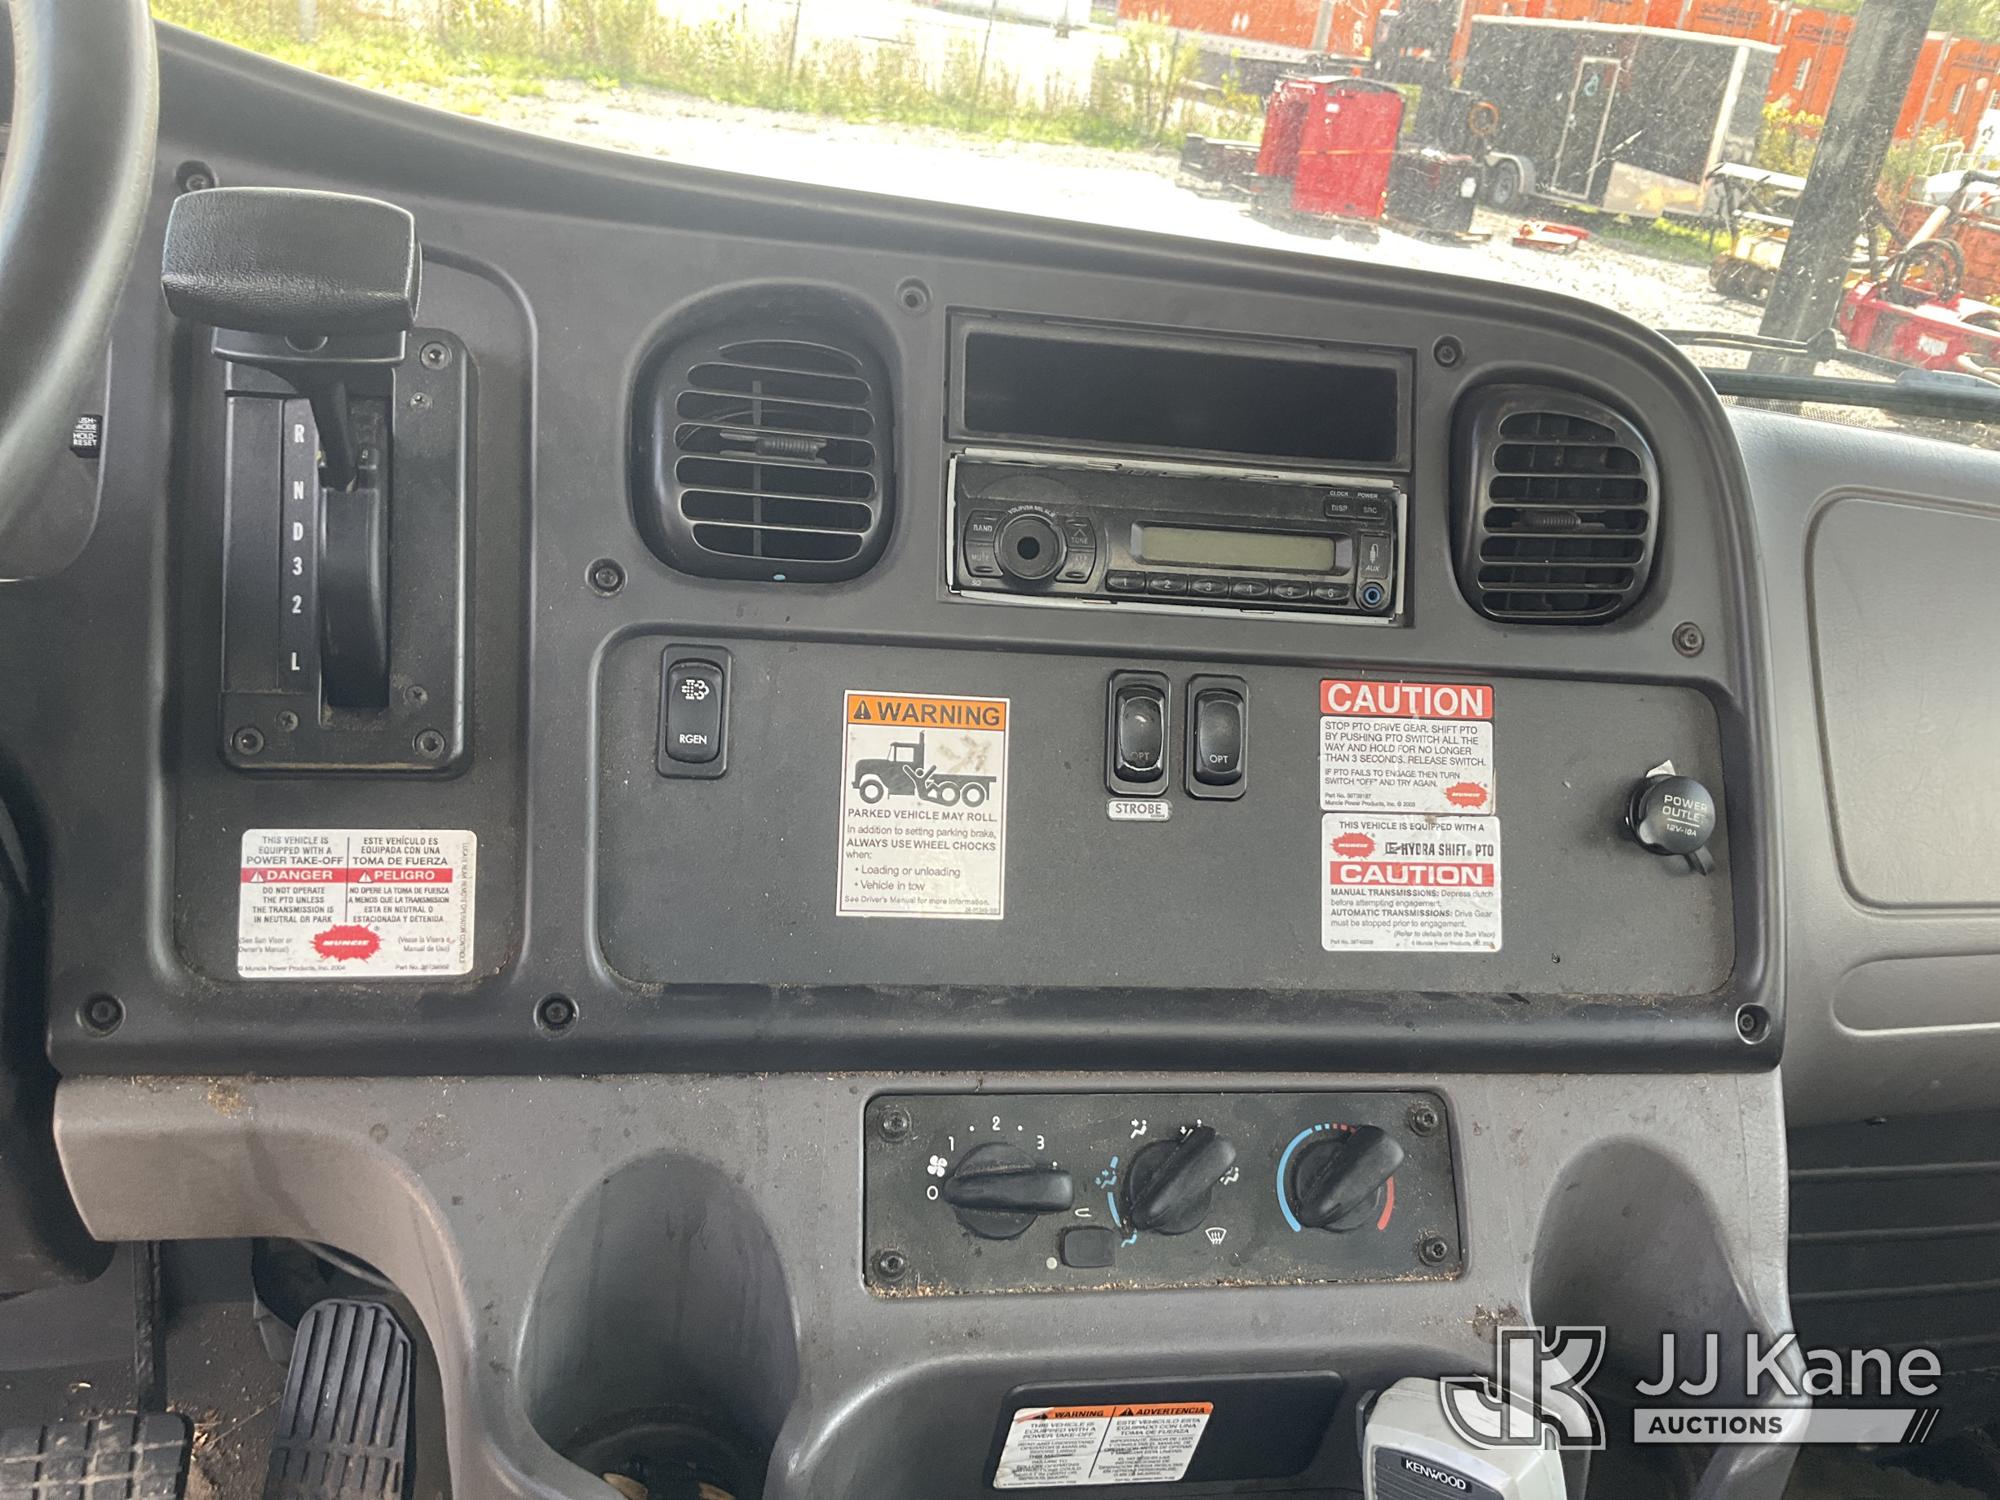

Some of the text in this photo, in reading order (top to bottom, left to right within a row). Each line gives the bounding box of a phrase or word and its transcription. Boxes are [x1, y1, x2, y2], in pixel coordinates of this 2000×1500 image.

[294, 423, 304, 443] R
[293, 481, 304, 500] N
[293, 522, 303, 541] D
[973, 524, 993, 532] BAND
[293, 557, 302, 575] 3
[1366, 564, 1380, 572] AUX
[1123, 578, 1127, 586] 1
[1164, 580, 1171, 589] 2
[1206, 582, 1211, 591] 3
[1288, 587, 1293, 596] 5
[1328, 588, 1333, 597] 6
[292, 595, 301, 613] 2
[291, 652, 300, 670] L
[1328, 683, 1483, 716] CAUTION
[877, 702, 1000, 726] WARNING
[1325, 722, 1349, 730] STOP
[1352, 723, 1370, 731] PTO
[1374, 723, 1401, 732] DRIVE
[1432, 725, 1457, 734] SHIFT
[1460, 726, 1477, 734] PTO
[679, 734, 707, 744] RGEN
[1325, 732, 1478, 745] BY PUSHING PTO SWITCH ALL THE
[1325, 743, 1471, 755] WAY AND HOLD FOR NO LONGER
[1210, 755, 1229, 764] OPT
[1325, 754, 1486, 766] THAN 3 SECONDS. RELEASE SWITCH.
[1386, 770, 1416, 778] ENGAGE
[1116, 803, 1161, 814] STROBE
[1664, 794, 1707, 812] POWER
[848, 809, 997, 822] PARKED VEHICLE MAY ROLL.
[848, 825, 996, 839] In addition to setting parking brake,
[1339, 821, 1359, 829] THIS
[1361, 821, 1397, 830] VEHICLE
[1400, 822, 1408, 830] IS
[1410, 822, 1452, 831] EQUIPPED
[1455, 823, 1476, 831] WITH
[263, 836, 281, 844] THIS
[364, 837, 383, 845] ESTE
[847, 839, 996, 851] ALWAYS USE WHEEL CHOCKS
[1439, 843, 1467, 856] SHIFT
[1476, 844, 1494, 857] PTO
[353, 857, 447, 865] TOMA DE FUERZA
[267, 870, 333, 880] DANGER
[374, 871, 435, 880] PELIGRO
[862, 865, 961, 878] Loading or unloading
[1340, 865, 1483, 884] CAUTION
[861, 880, 925, 890] Vehicle in tow
[1368, 889, 1439, 897] TRANSMISSIONS:
[1441, 890, 1471, 898] Depress
[1473, 890, 1493, 898] clutch
[1331, 909, 1381, 917] AUTOMATIC
[1455, 910, 1473, 918] Drive
[1475, 910, 1492, 918] Gear
[992, 1116, 1000, 1131] 2
[949, 1136, 955, 1151] 1
[1036, 1135, 1045, 1150] 3
[1055, 1410, 1104, 1418] WARNING
[1406, 1460, 1466, 1490] KENWOOD
